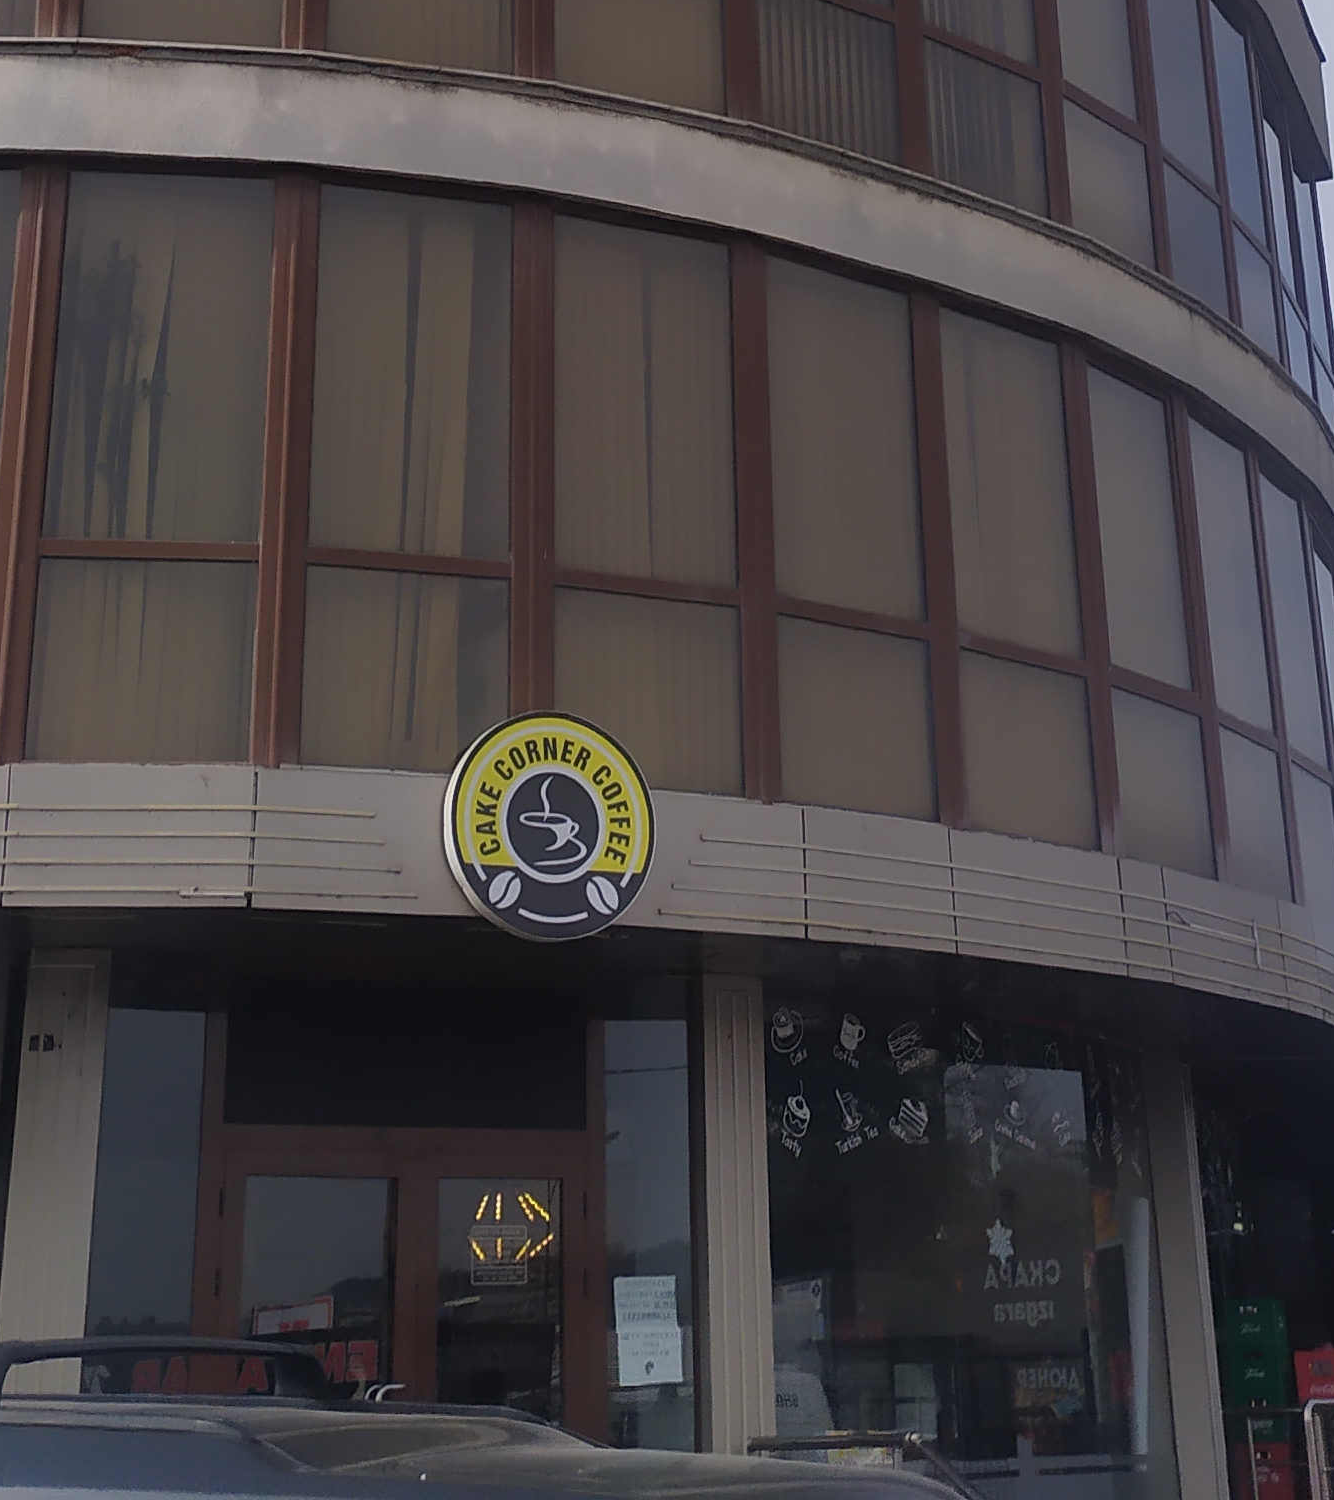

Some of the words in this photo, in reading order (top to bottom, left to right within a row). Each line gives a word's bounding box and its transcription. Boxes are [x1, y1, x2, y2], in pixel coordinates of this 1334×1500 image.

[475, 781, 503, 856] CAKE
[493, 736, 592, 781] CORNER
[592, 764, 631, 866] COFFEE
[781, 1129, 803, 1160] Tasty
[834, 1132, 864, 1156] Turkish
[864, 1125, 880, 1141] Tea
